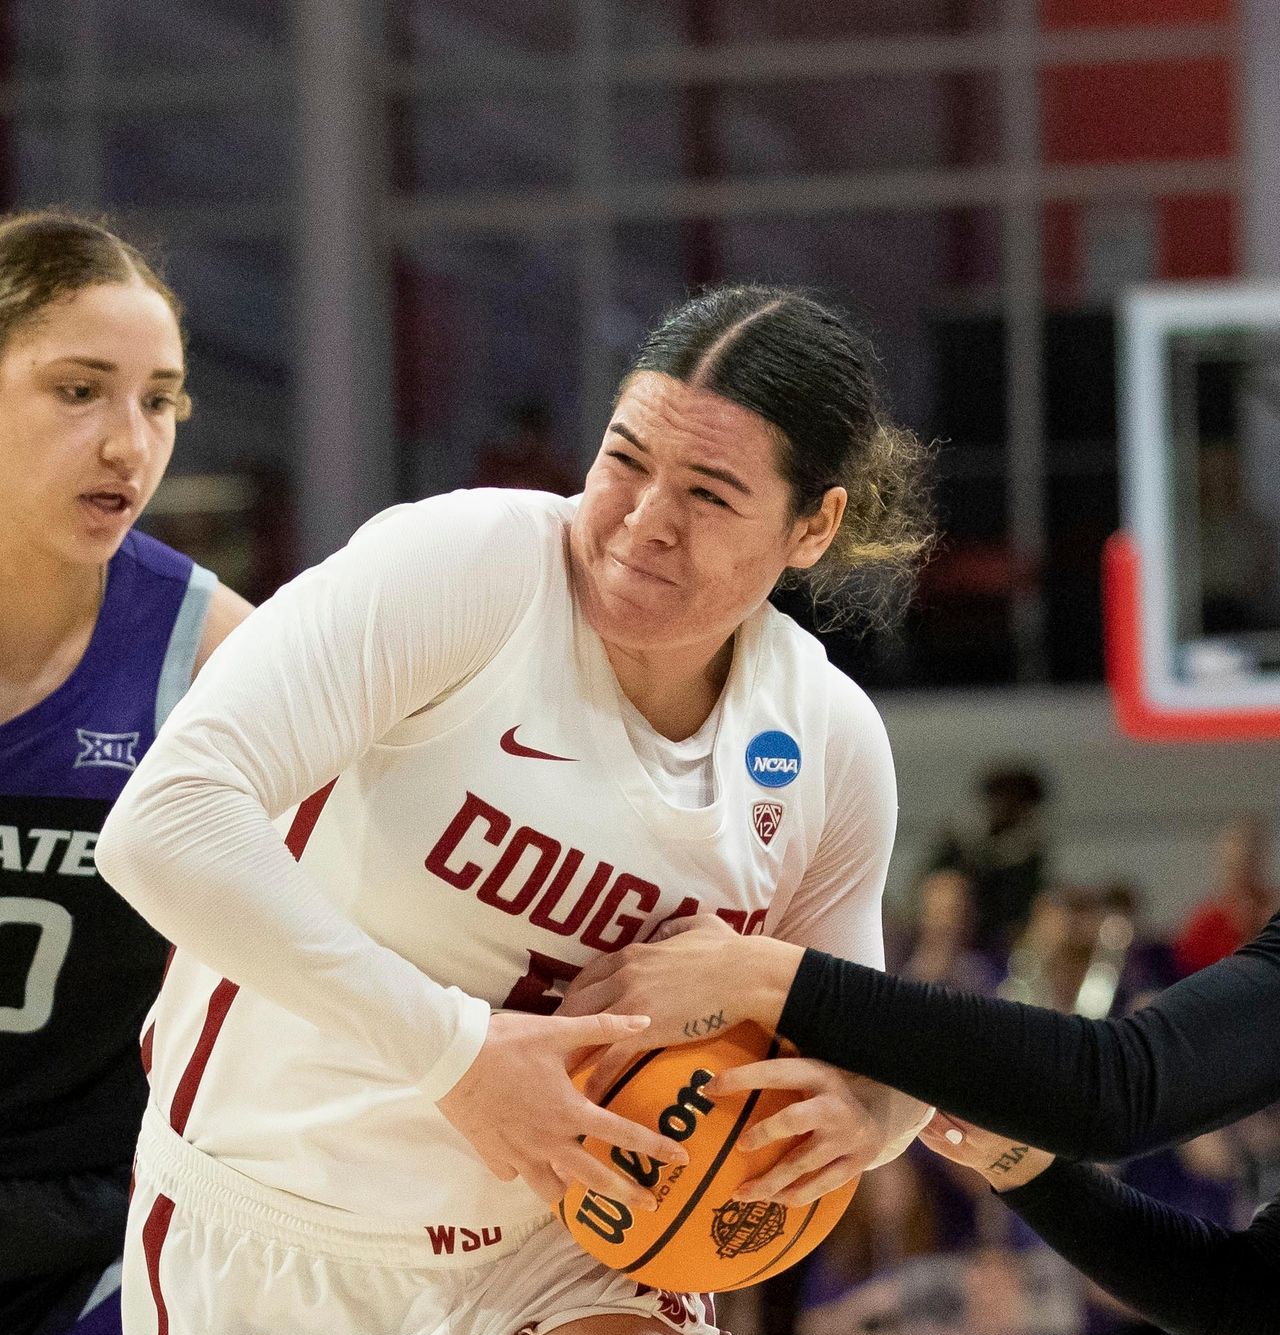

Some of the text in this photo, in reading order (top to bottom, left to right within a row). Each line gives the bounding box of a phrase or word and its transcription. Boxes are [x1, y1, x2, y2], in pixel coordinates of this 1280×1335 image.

[753, 756, 798, 773] NCAA
[754, 804, 782, 829] PAC
[759, 821, 773, 837] 12
